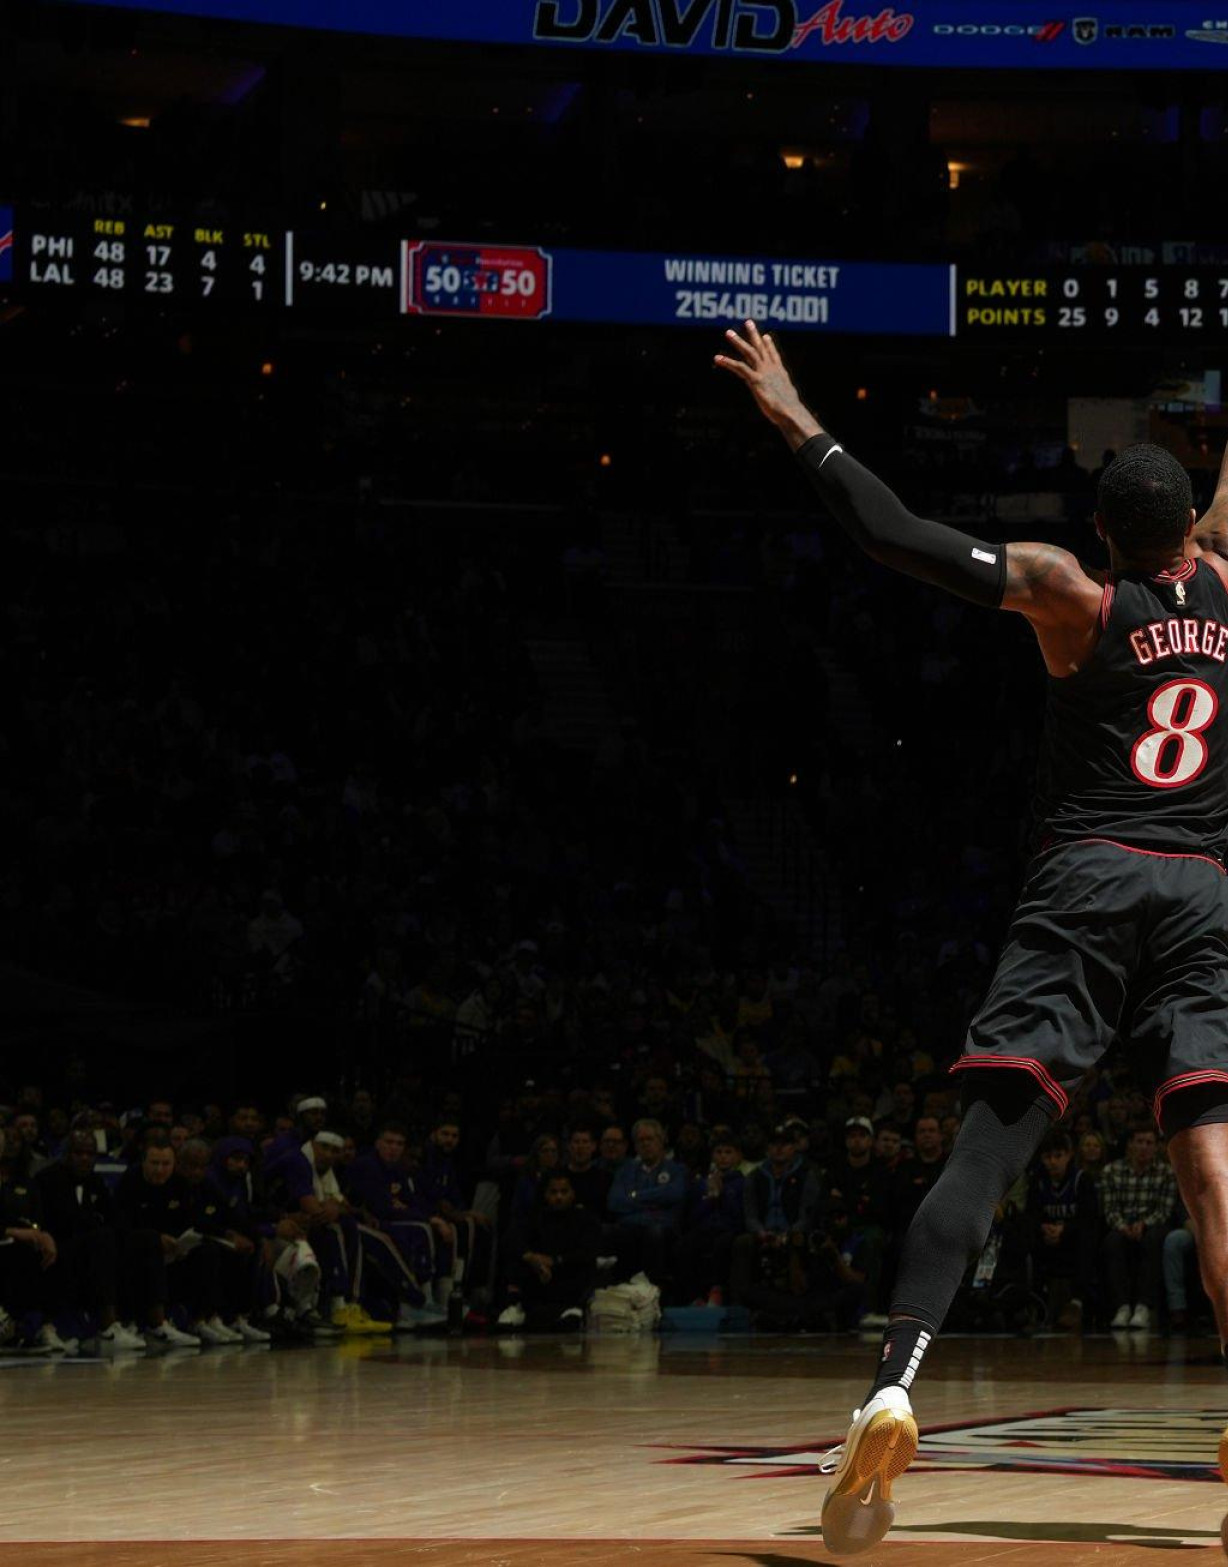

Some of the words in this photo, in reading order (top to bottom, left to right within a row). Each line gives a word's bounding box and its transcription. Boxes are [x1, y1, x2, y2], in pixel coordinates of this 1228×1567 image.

[533, 0, 796, 54] DAVID
[790, 0, 914, 46] Auto
[933, 25, 1045, 35] DODGE
[1105, 25, 1174, 38] RAM
[95, 220, 124, 234] REB
[144, 225, 173, 238] AST
[195, 229, 222, 243] BLK
[244, 234, 269, 248] STL
[32, 235, 73, 257] PHI
[94, 241, 124, 262] 48
[147, 246, 170, 265] 17
[201, 251, 216, 270] 4
[250, 255, 265, 274] 4
[31, 262, 73, 284] LAL
[94, 268, 124, 288] 48
[145, 272, 173, 292] 23
[202, 277, 214, 295] 7
[253, 281, 262, 300] 1
[300, 262, 349, 283] 9:42
[356, 266, 392, 286] PM
[424, 264, 462, 293] 50
[500, 269, 536, 297] 50
[665, 260, 765, 285] WINNING
[772, 264, 839, 288] TICKET
[967, 280, 1046, 296] PLAYER
[1064, 279, 1078, 297] 0
[1107, 279, 1116, 297] 1
[1145, 279, 1158, 298] 5
[1185, 280, 1198, 298] 8
[675, 290, 828, 322] 2154064001
[968, 309, 1045, 324] POINTS
[1059, 308, 1086, 326] 25
[1105, 308, 1118, 326] 9
[1145, 308, 1159, 326] 4
[1180, 308, 1202, 326] 12
[1130, 678, 1219, 788] 8
